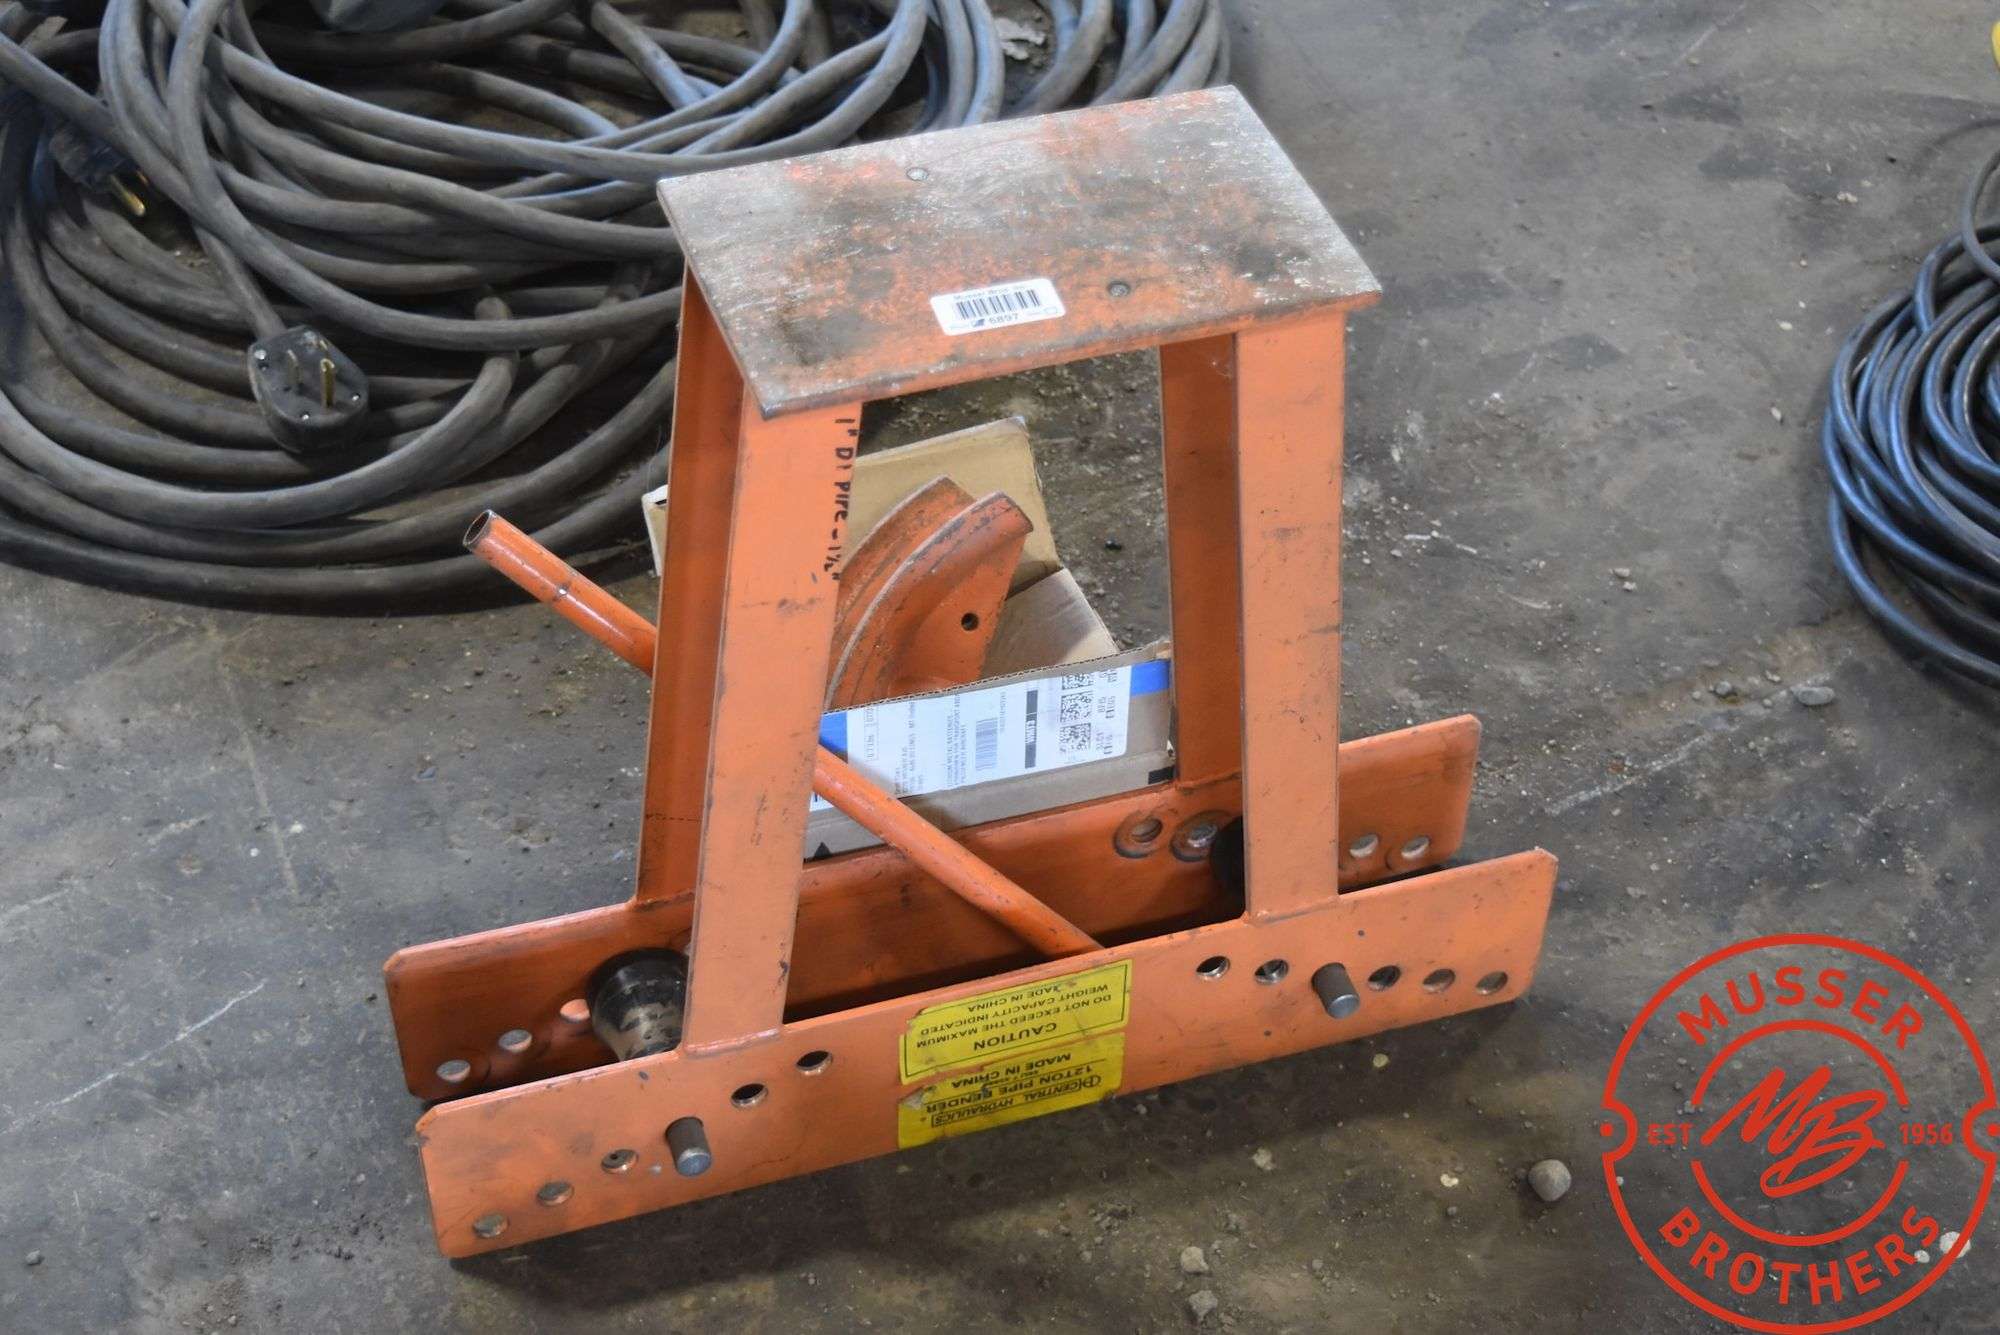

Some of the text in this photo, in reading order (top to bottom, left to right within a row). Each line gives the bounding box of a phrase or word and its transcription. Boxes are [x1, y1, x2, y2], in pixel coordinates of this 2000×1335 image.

[967, 996, 1008, 1013] CHINA
[1010, 991, 1024, 1003] IN
[920, 983, 1109, 1036] WEIGHT CAPACITY INDICATED
[916, 994, 1112, 1048] DO NOT EXCEED THE MAXIMUM
[973, 1022, 1057, 1051] CAUTION
[1005, 1065, 1020, 1076] IN
[1025, 1053, 1072, 1072] MADE
[951, 1071, 1000, 1090] CHINA
[999, 1078, 1034, 1096] PIPE
[926, 1086, 993, 1114] BENDER
[933, 1080, 1077, 1127] CENTRAL HYDRAULICS
